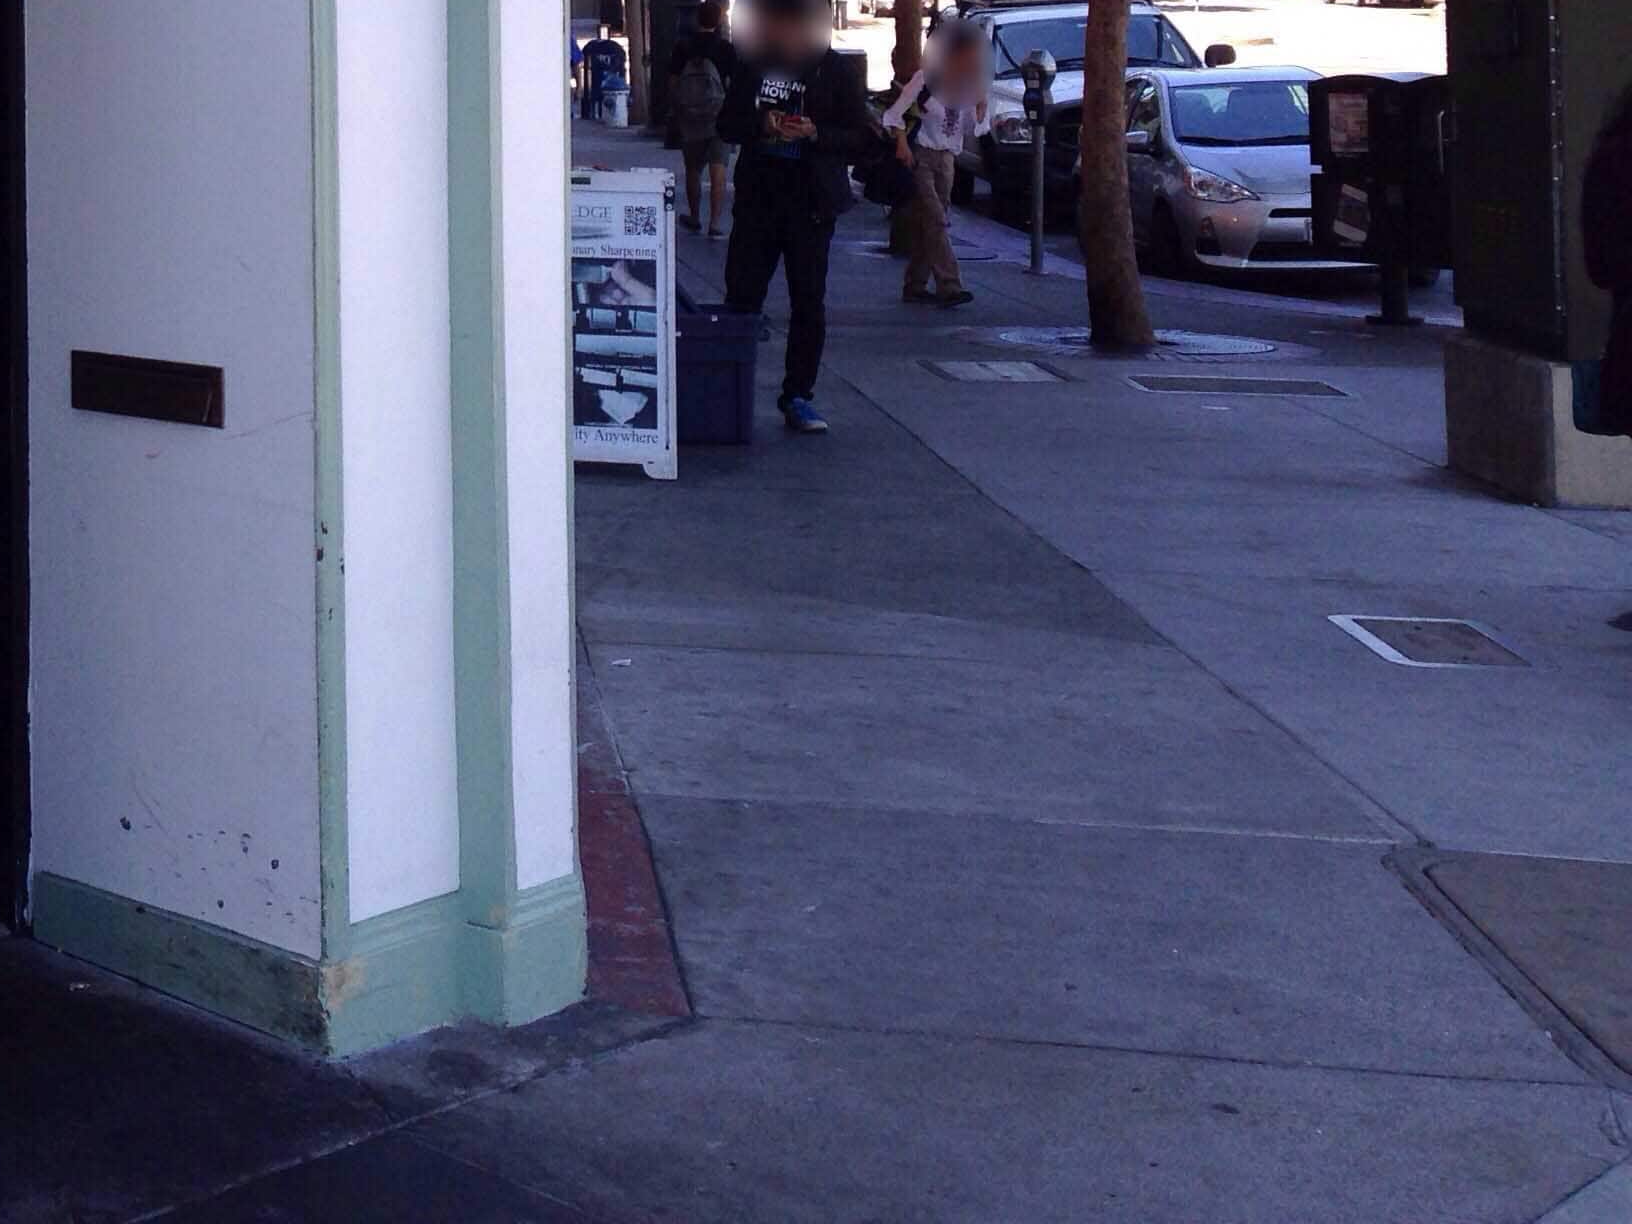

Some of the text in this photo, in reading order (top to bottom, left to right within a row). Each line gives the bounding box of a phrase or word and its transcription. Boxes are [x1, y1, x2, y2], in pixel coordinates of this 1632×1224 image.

[576, 206, 614, 219] DGE
[600, 244, 657, 258] Sharpening
[595, 429, 659, 446] Anywhere
